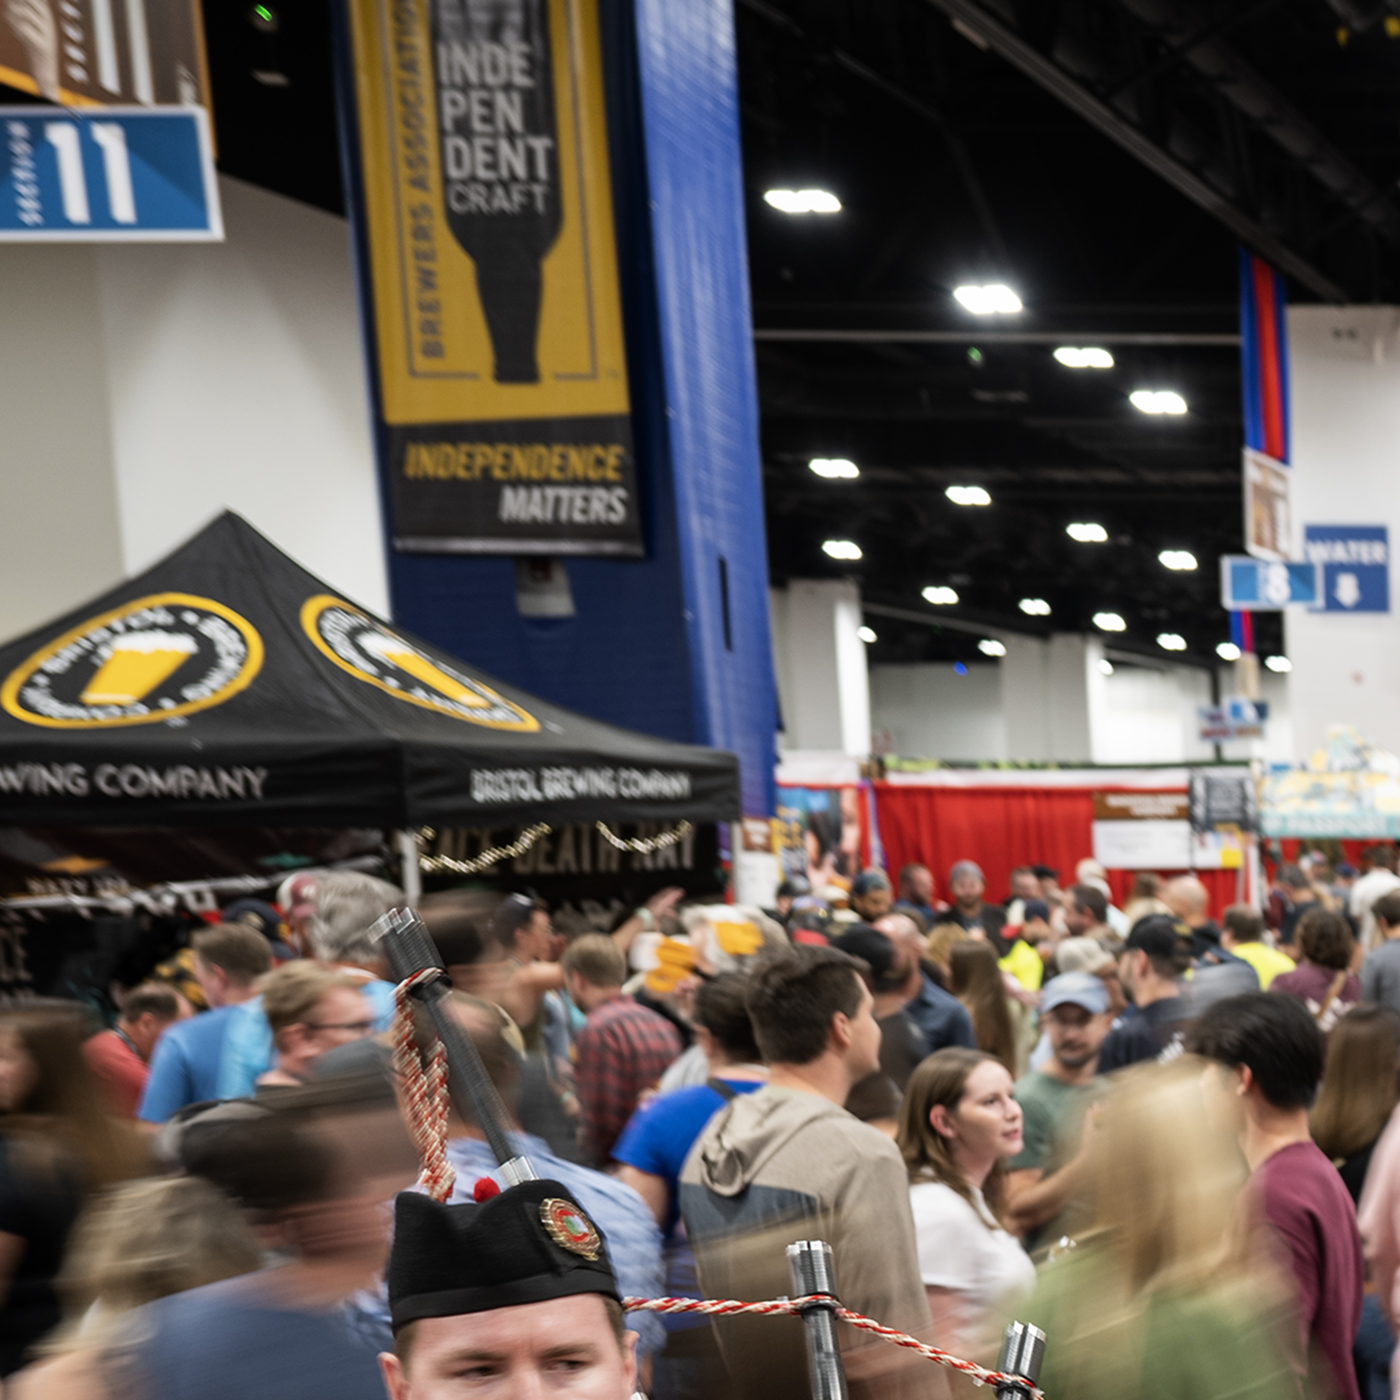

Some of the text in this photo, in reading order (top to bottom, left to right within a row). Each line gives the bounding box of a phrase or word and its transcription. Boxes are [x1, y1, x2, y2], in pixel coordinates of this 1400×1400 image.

[437, 42, 535, 88] INDE
[443, 89, 525, 134] PEN
[45, 121, 138, 226] 11
[394, 0, 446, 360] BREWERS ASSOCIATIO
[445, 135, 554, 182] DENT
[448, 183, 550, 215] CRAFT
[403, 441, 625, 482] INDEPENDENCE
[500, 484, 630, 525] MATTERS
[0, 764, 268, 799] WING COMPANY
